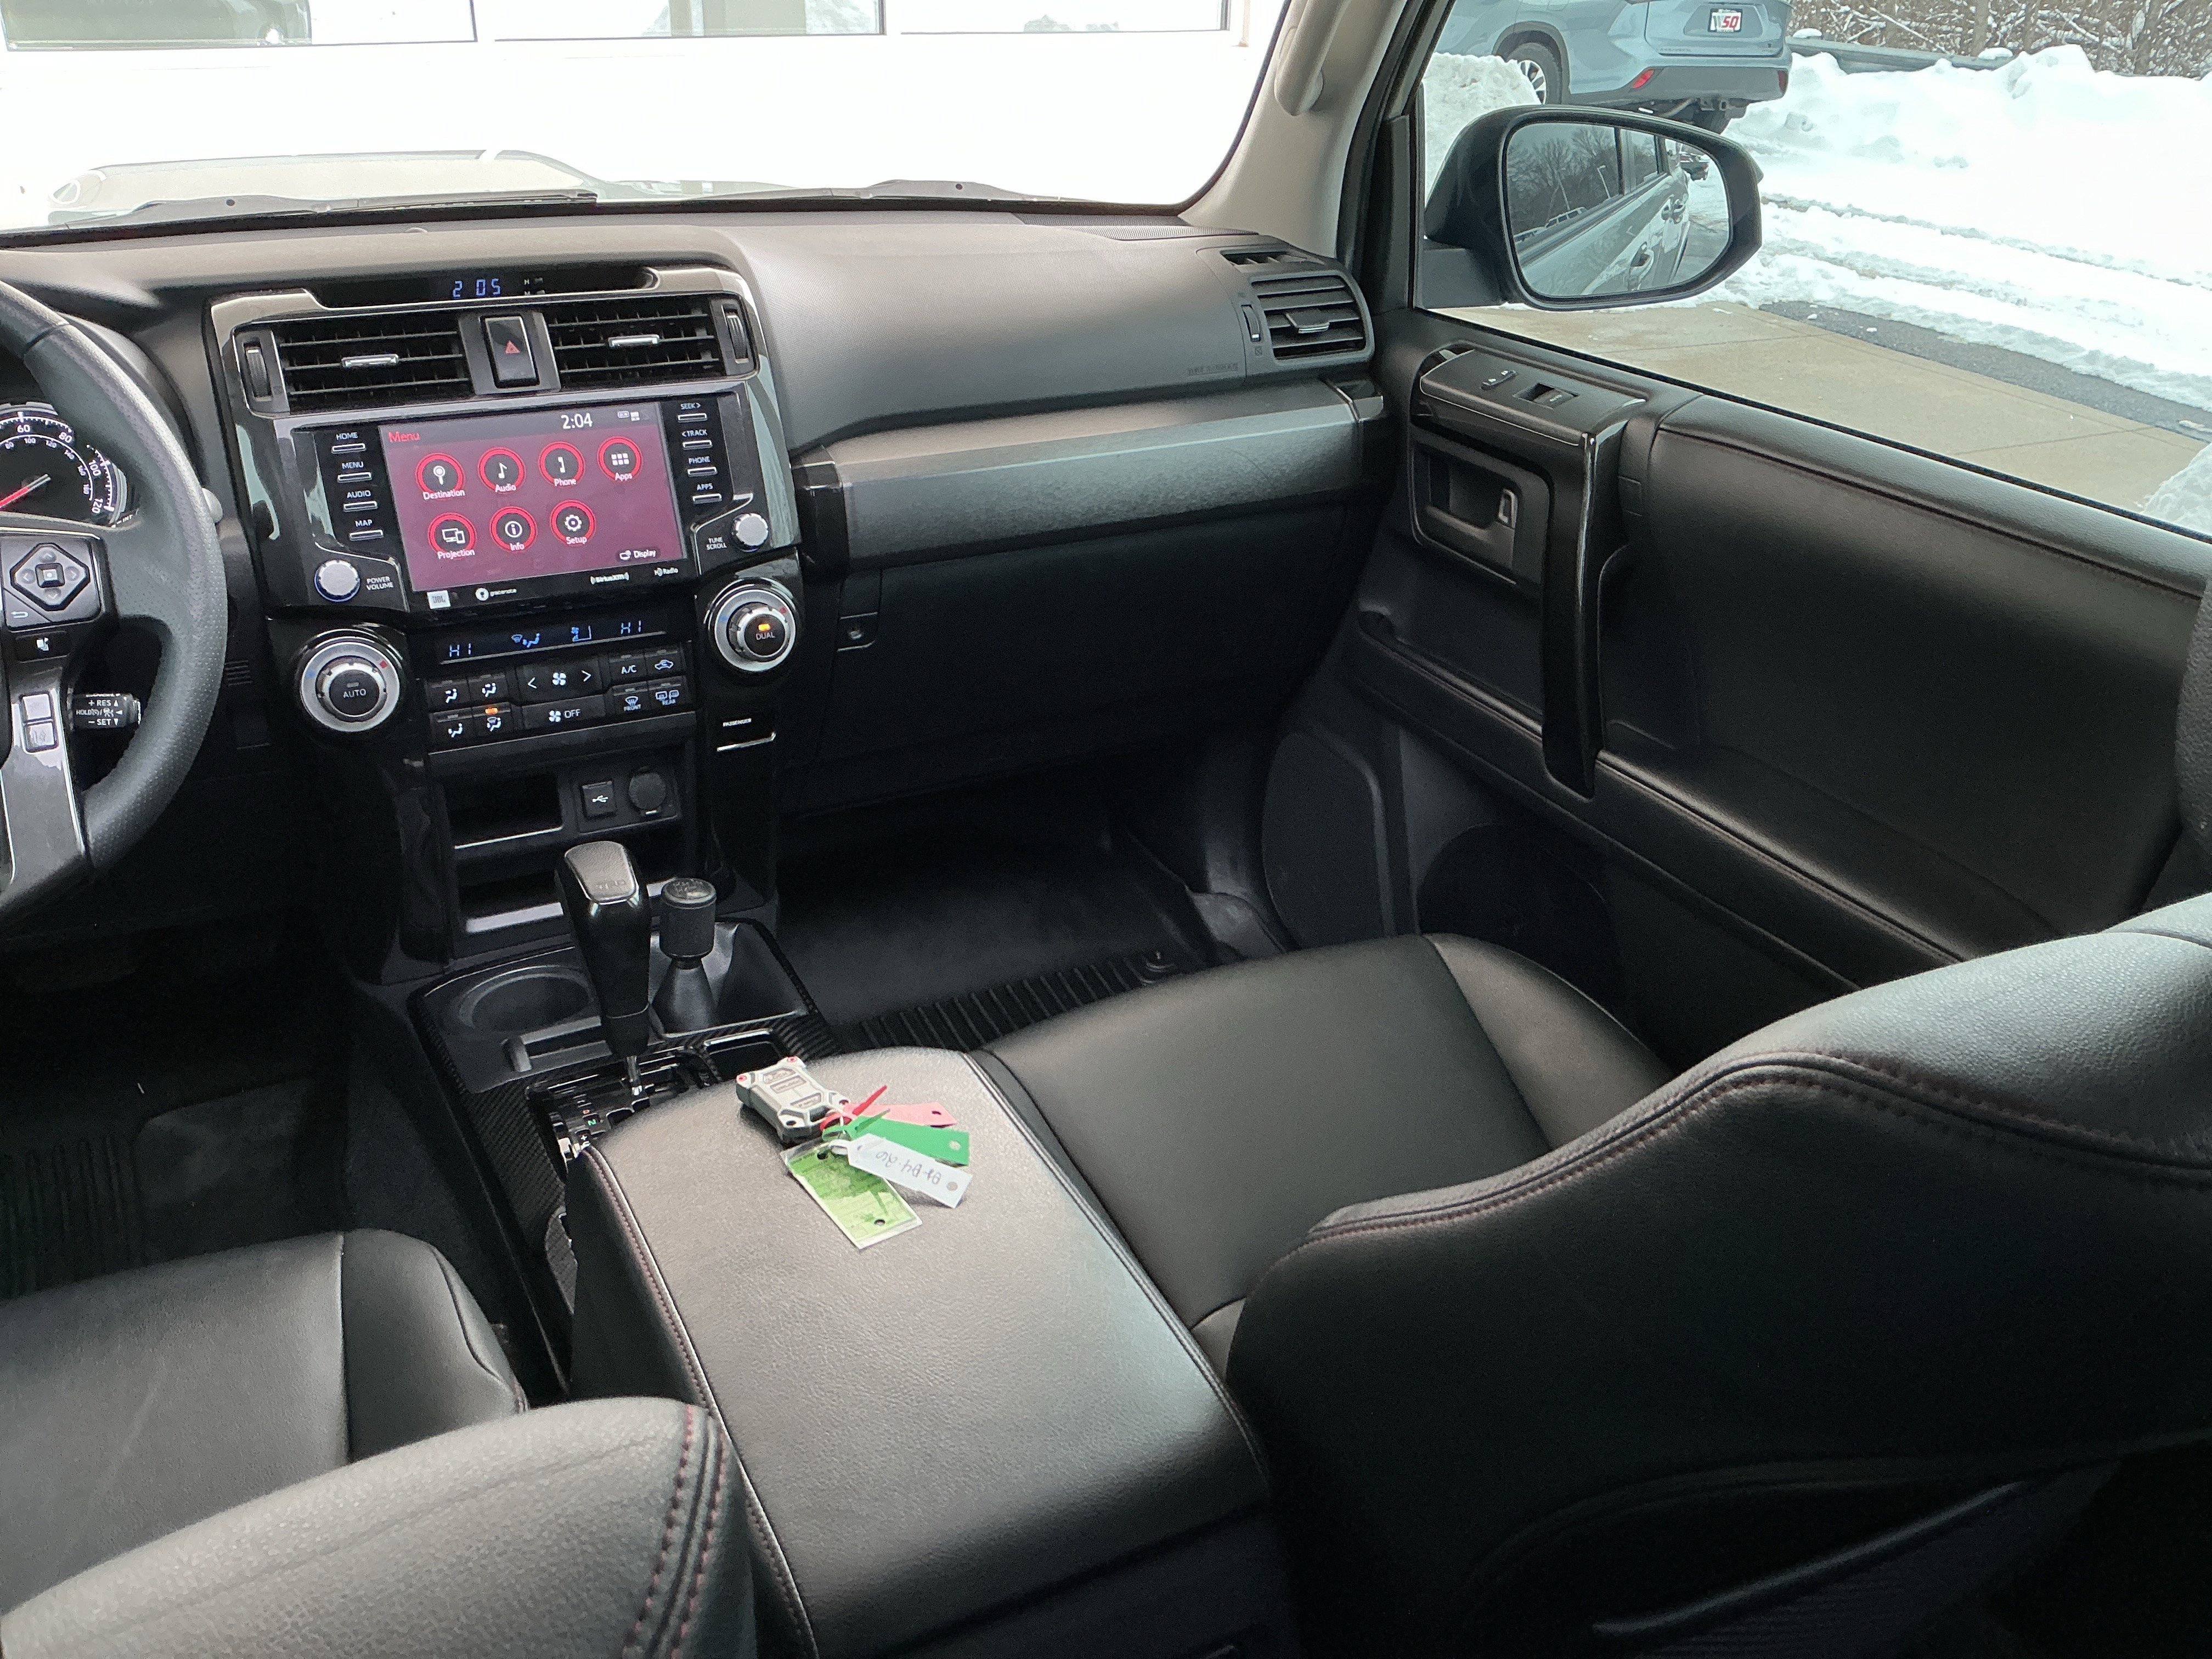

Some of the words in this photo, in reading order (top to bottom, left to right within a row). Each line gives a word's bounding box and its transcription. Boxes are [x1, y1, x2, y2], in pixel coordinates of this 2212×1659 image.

[561, 413, 593, 429] 2:04
[17, 425, 31, 433] 60
[58, 432, 72, 444] 80
[336, 432, 358, 440] HOME
[388, 431, 420, 442] Menu
[46, 440, 57, 448] 120
[689, 456, 710, 464] PHONE
[88, 459, 101, 476] 100
[554, 477, 577, 486] Phone
[615, 472, 633, 482] Apps
[495, 484, 516, 492] Audio
[423, 489, 465, 500] Destination
[91, 498, 104, 514] 120
[566, 535, 588, 545] Setup
[510, 542, 524, 550] Info
[707, 542, 727, 550] SCROLL
[438, 548, 475, 560] Projection
[633, 550, 657, 559] Display
[367, 576, 390, 585] POWER
[366, 581, 393, 591] VOLUME
[755, 631, 776, 640] DUAL
[621, 665, 636, 674] A/C
[343, 688, 366, 698] AUTO
[565, 709, 580, 719] OFF
